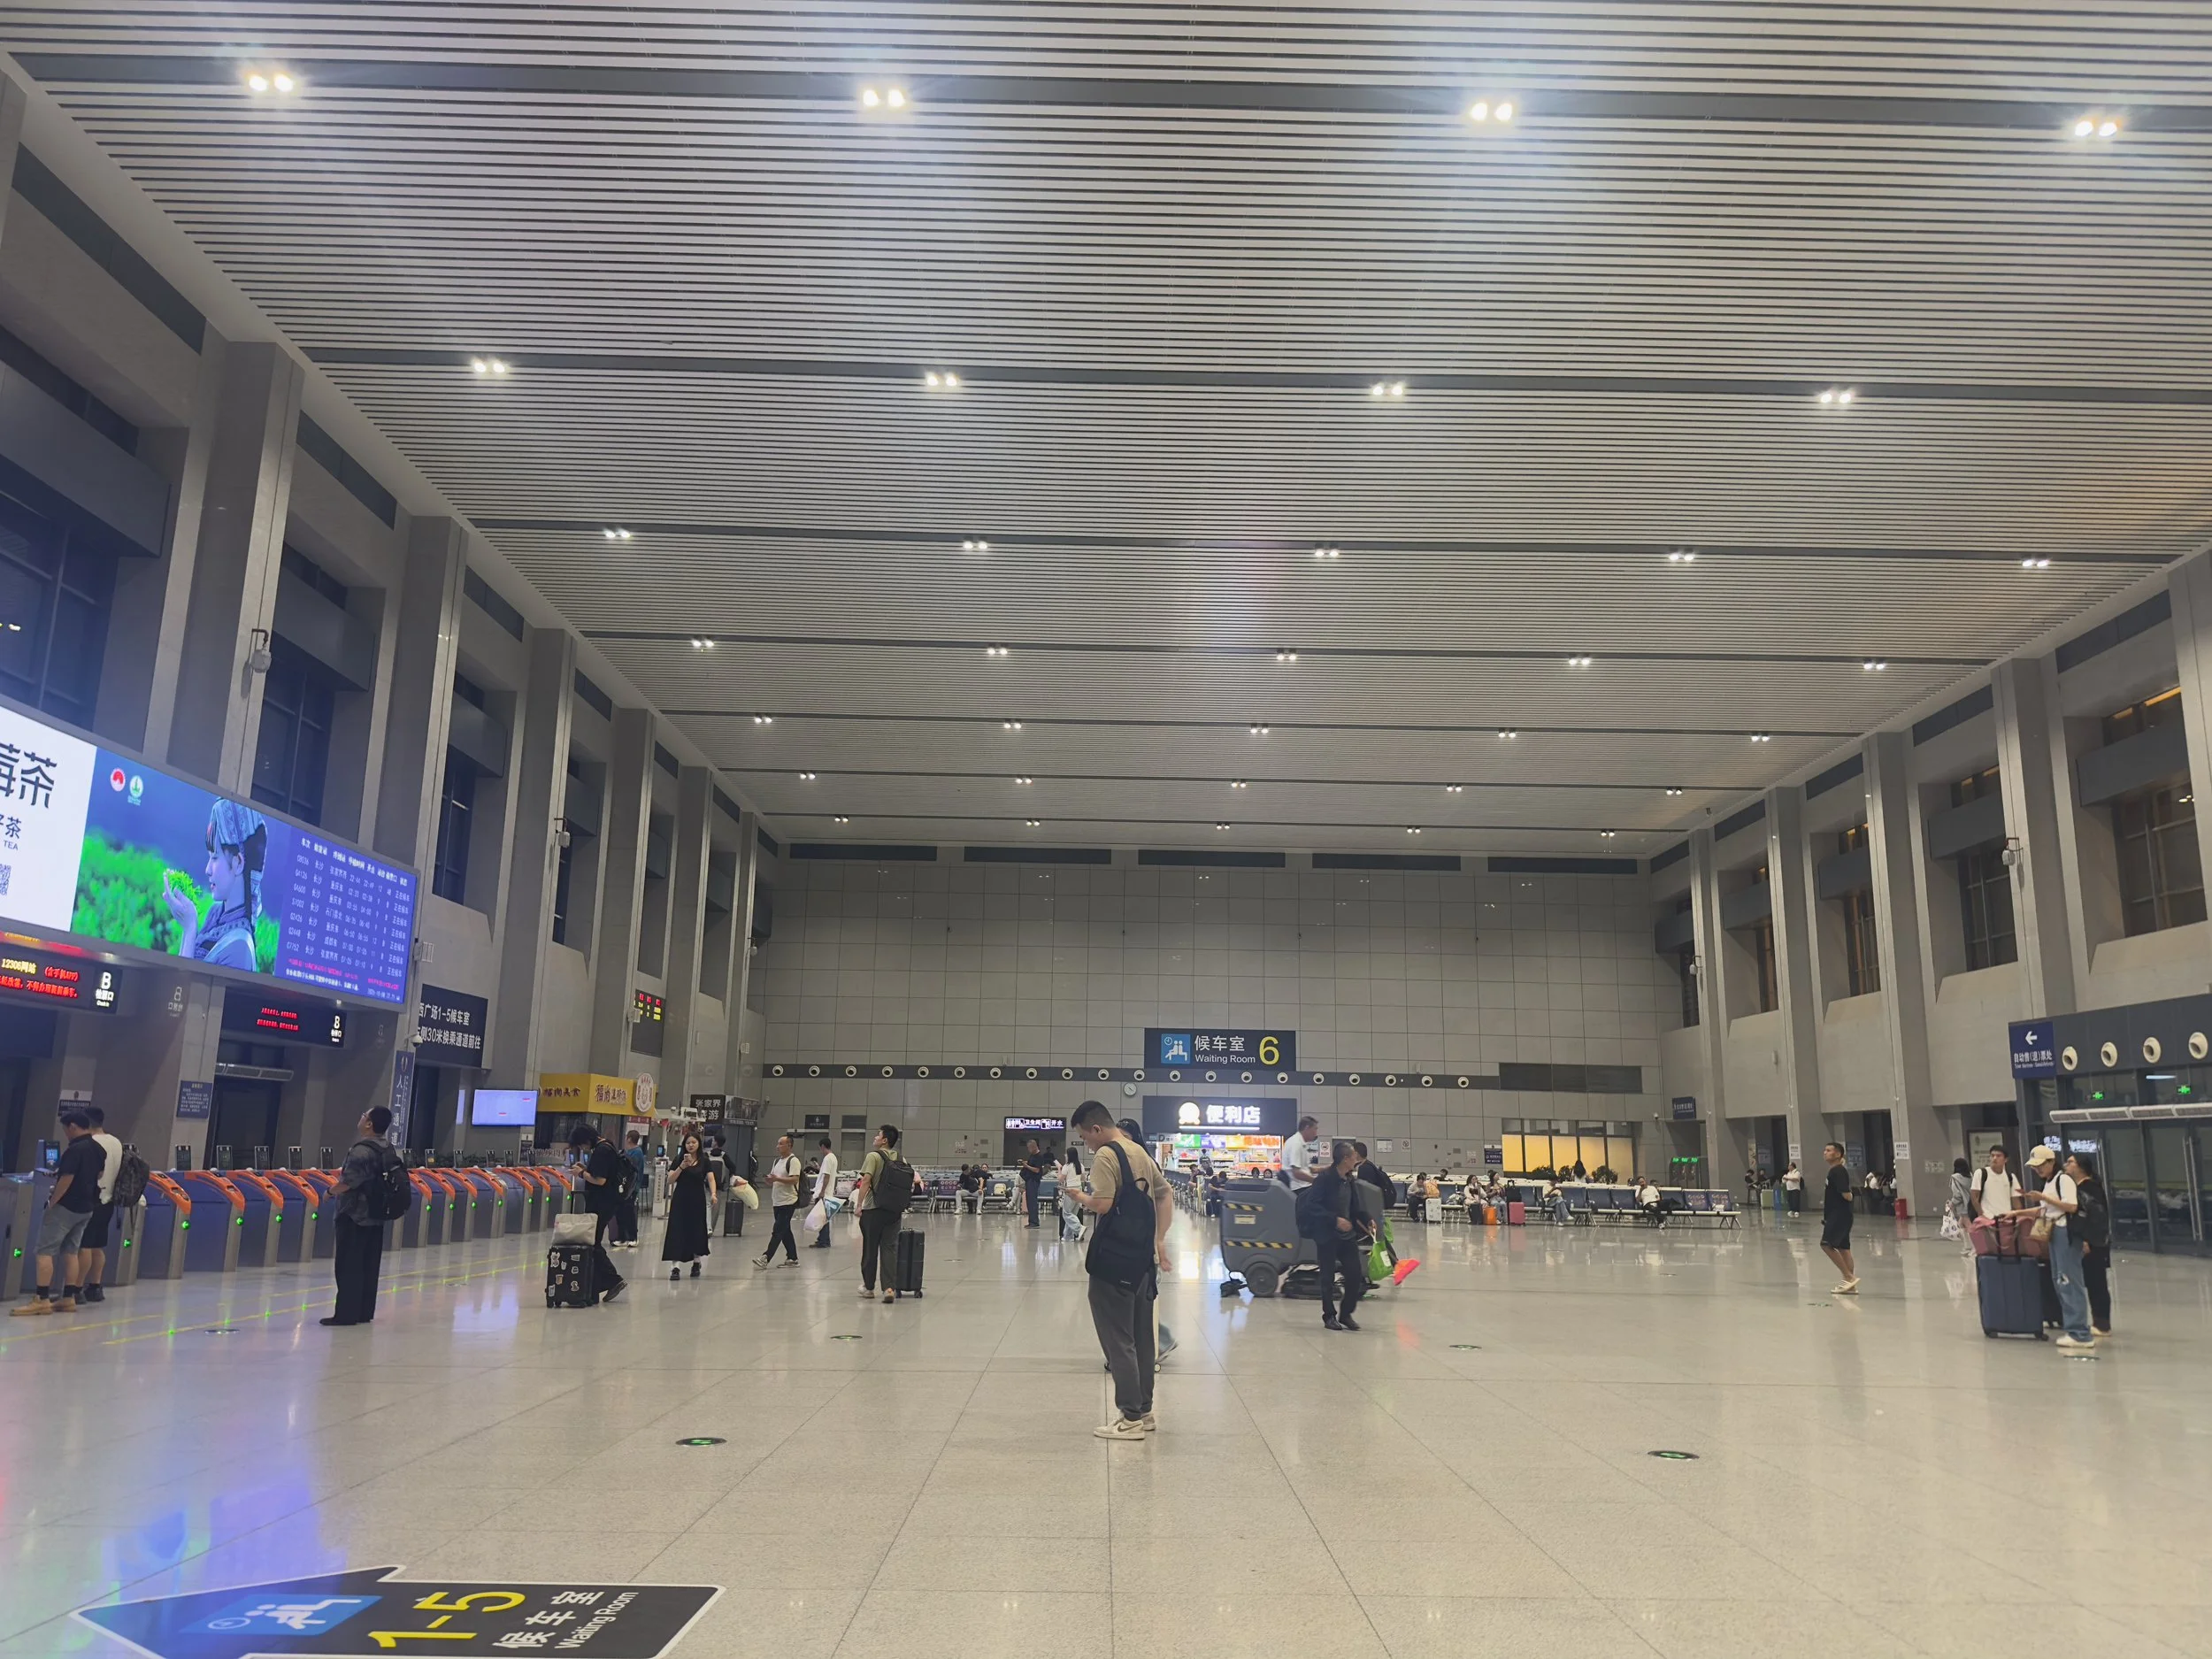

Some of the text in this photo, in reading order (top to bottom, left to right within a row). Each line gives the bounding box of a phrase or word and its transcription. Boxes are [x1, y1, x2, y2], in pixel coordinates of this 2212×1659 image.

[4, 840, 19, 850] TEA
[1, 958, 37, 975] 12306网站
[101, 972, 112, 990] B
[334, 1016, 341, 1029] B
[417, 1025, 481, 1049] 侧30米换乘通道前往
[1194, 1035, 1279, 1065] 候车室 6
[1194, 1054, 1256, 1064] Waiting Room
[695, 1099, 721, 1108] 张家界
[1206, 1104, 1261, 1124] 便利店
[368, 1591, 526, 1648] 1-5
[492, 1591, 605, 1648] 候车室
[554, 1592, 640, 1649] Waiting Room
